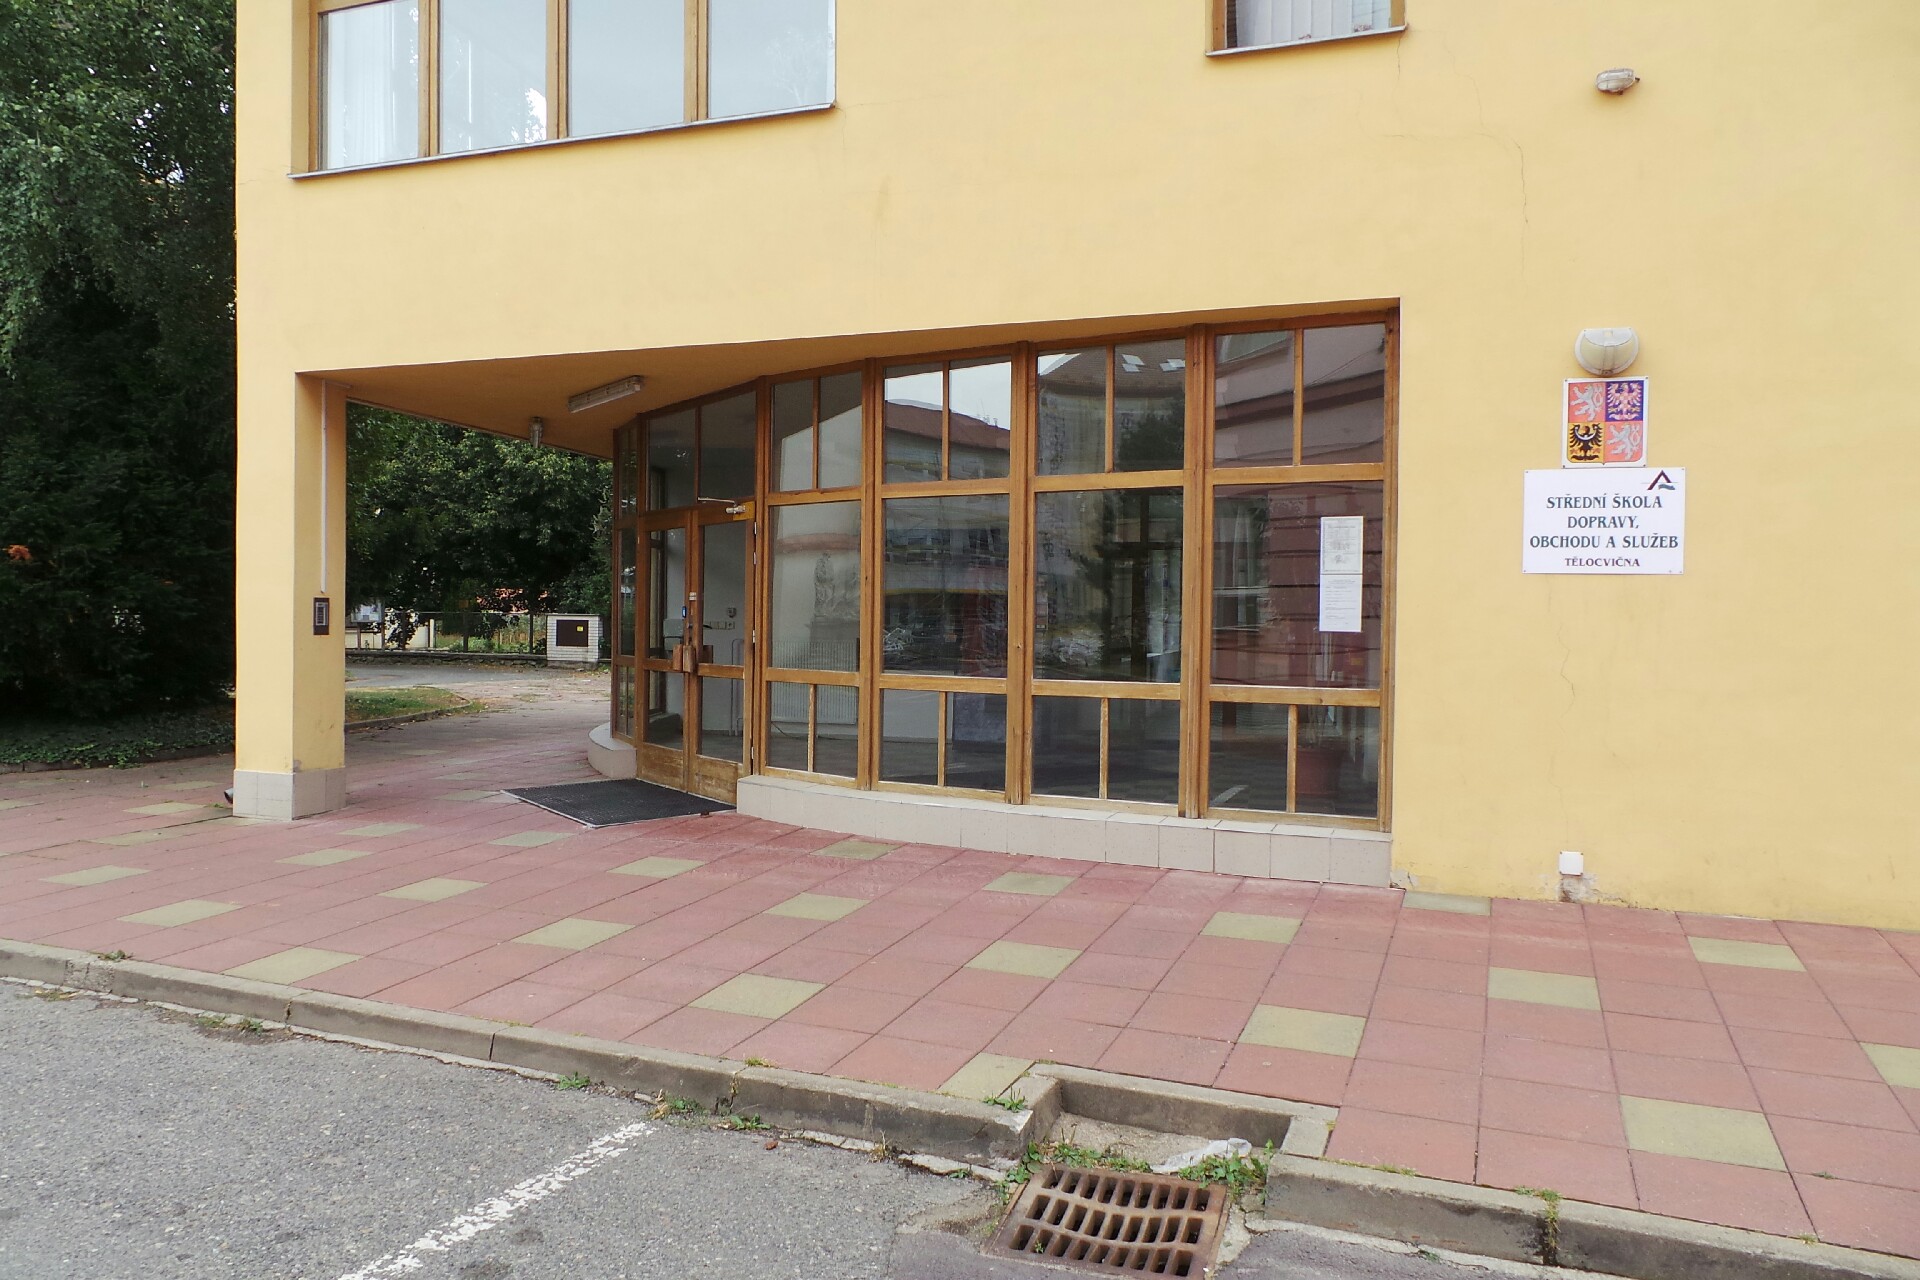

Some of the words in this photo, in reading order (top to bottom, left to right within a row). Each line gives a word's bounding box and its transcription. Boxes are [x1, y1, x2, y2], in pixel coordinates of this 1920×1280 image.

[1546, 493, 1607, 509] STŘEDNÍ
[1612, 493, 1663, 509] ŠKOLA
[1567, 516, 1640, 529] DOPRAVY,
[1529, 536, 1601, 549] OBCHODU
[1605, 536, 1616, 549] A
[1622, 533, 1679, 549] SLUŽEB
[1564, 556, 1641, 567] TĚLOCVIČNA
